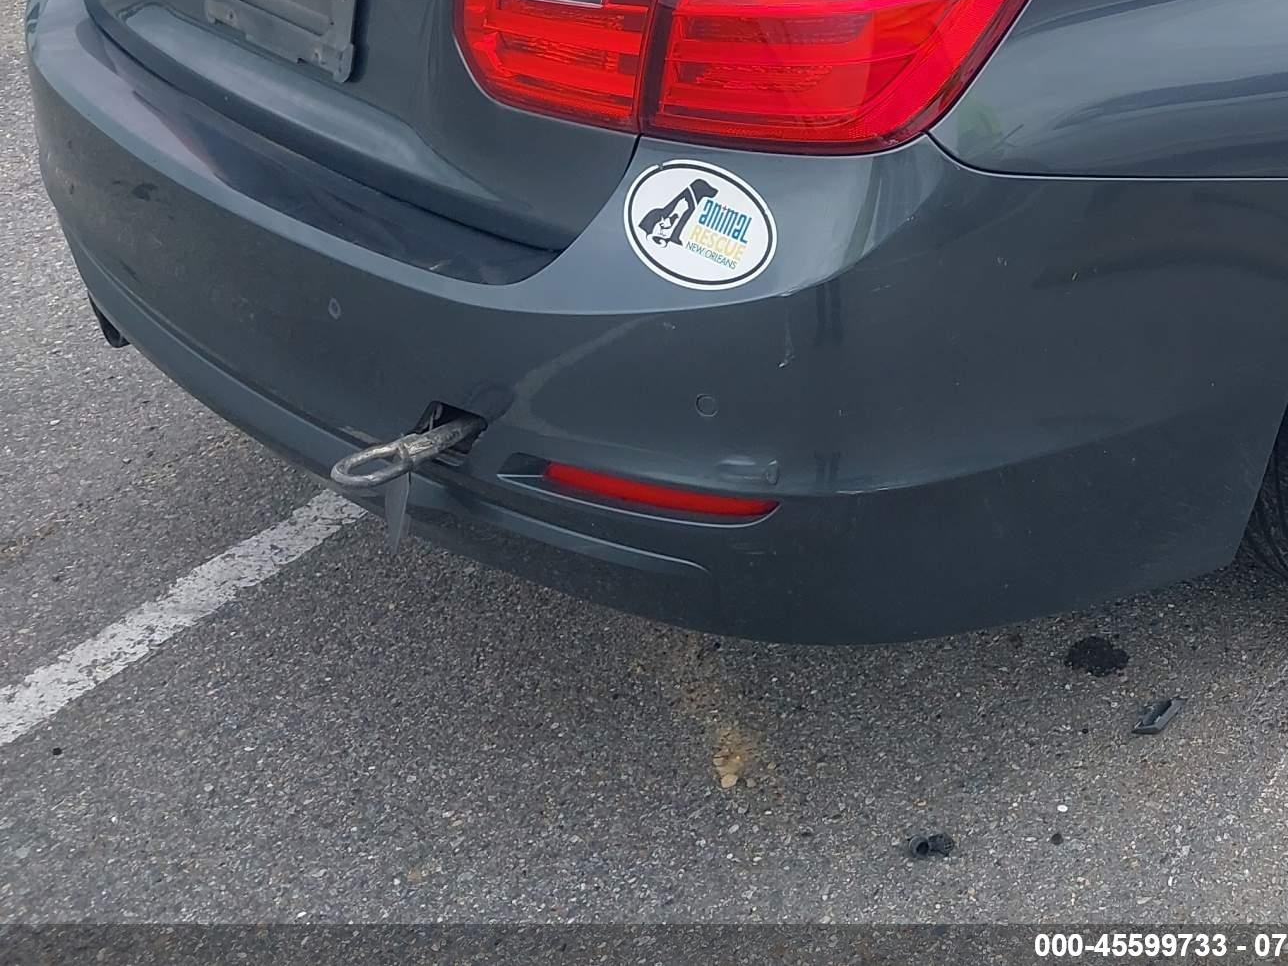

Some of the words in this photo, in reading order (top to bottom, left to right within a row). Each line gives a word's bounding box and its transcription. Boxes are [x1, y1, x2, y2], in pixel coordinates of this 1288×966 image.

[686, 241, 704, 255] NEW
[704, 249, 737, 270] ORLEANS
[690, 224, 746, 261] RESCUE
